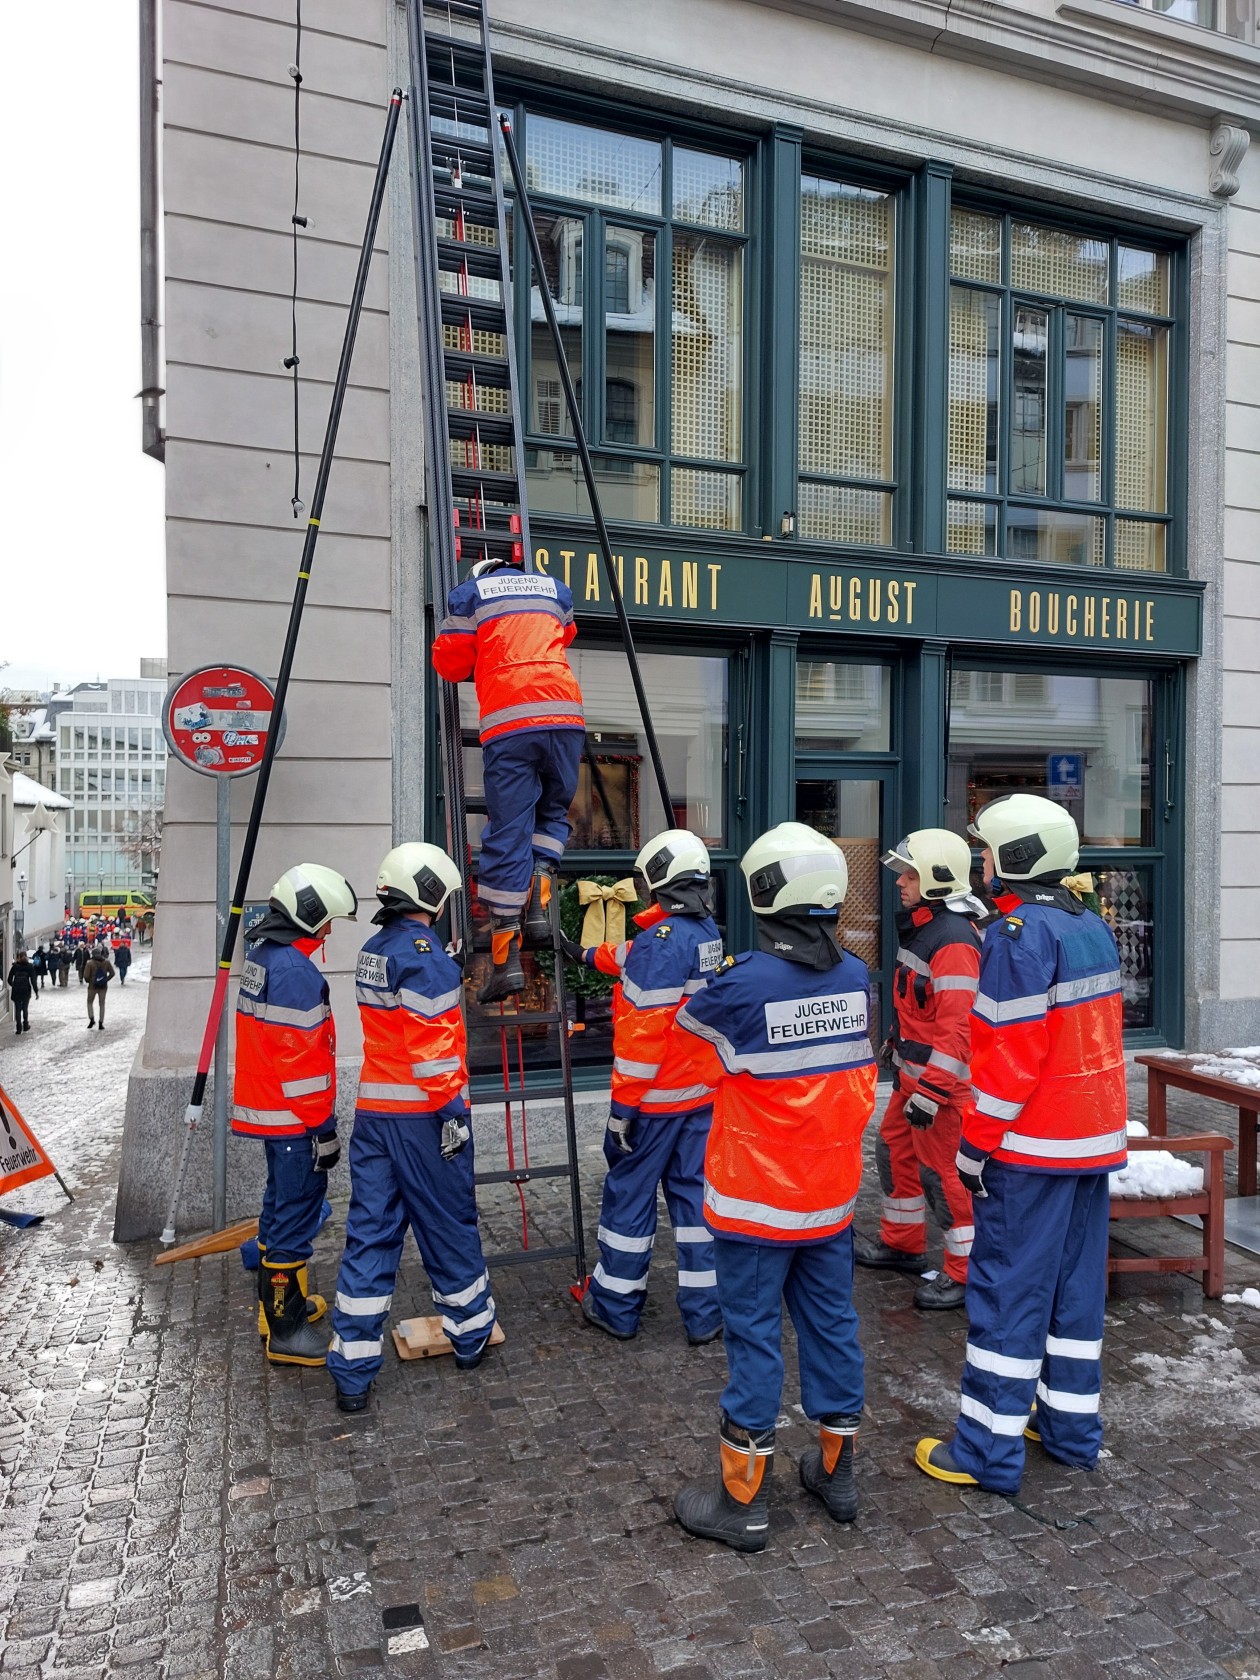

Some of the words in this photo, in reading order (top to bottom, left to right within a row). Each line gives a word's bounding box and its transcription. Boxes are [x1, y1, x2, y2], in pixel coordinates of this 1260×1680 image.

[482, 585, 556, 596] FEUERWEHR
[498, 577, 539, 585] JUGEND
[809, 573, 917, 624] AUGUST
[1009, 589, 1154, 641] BOUCHERIE
[794, 999, 848, 1019] JUGEND
[770, 1013, 866, 1040] FEUERWEHR
[0, 1146, 37, 1173] Feuerwehr
